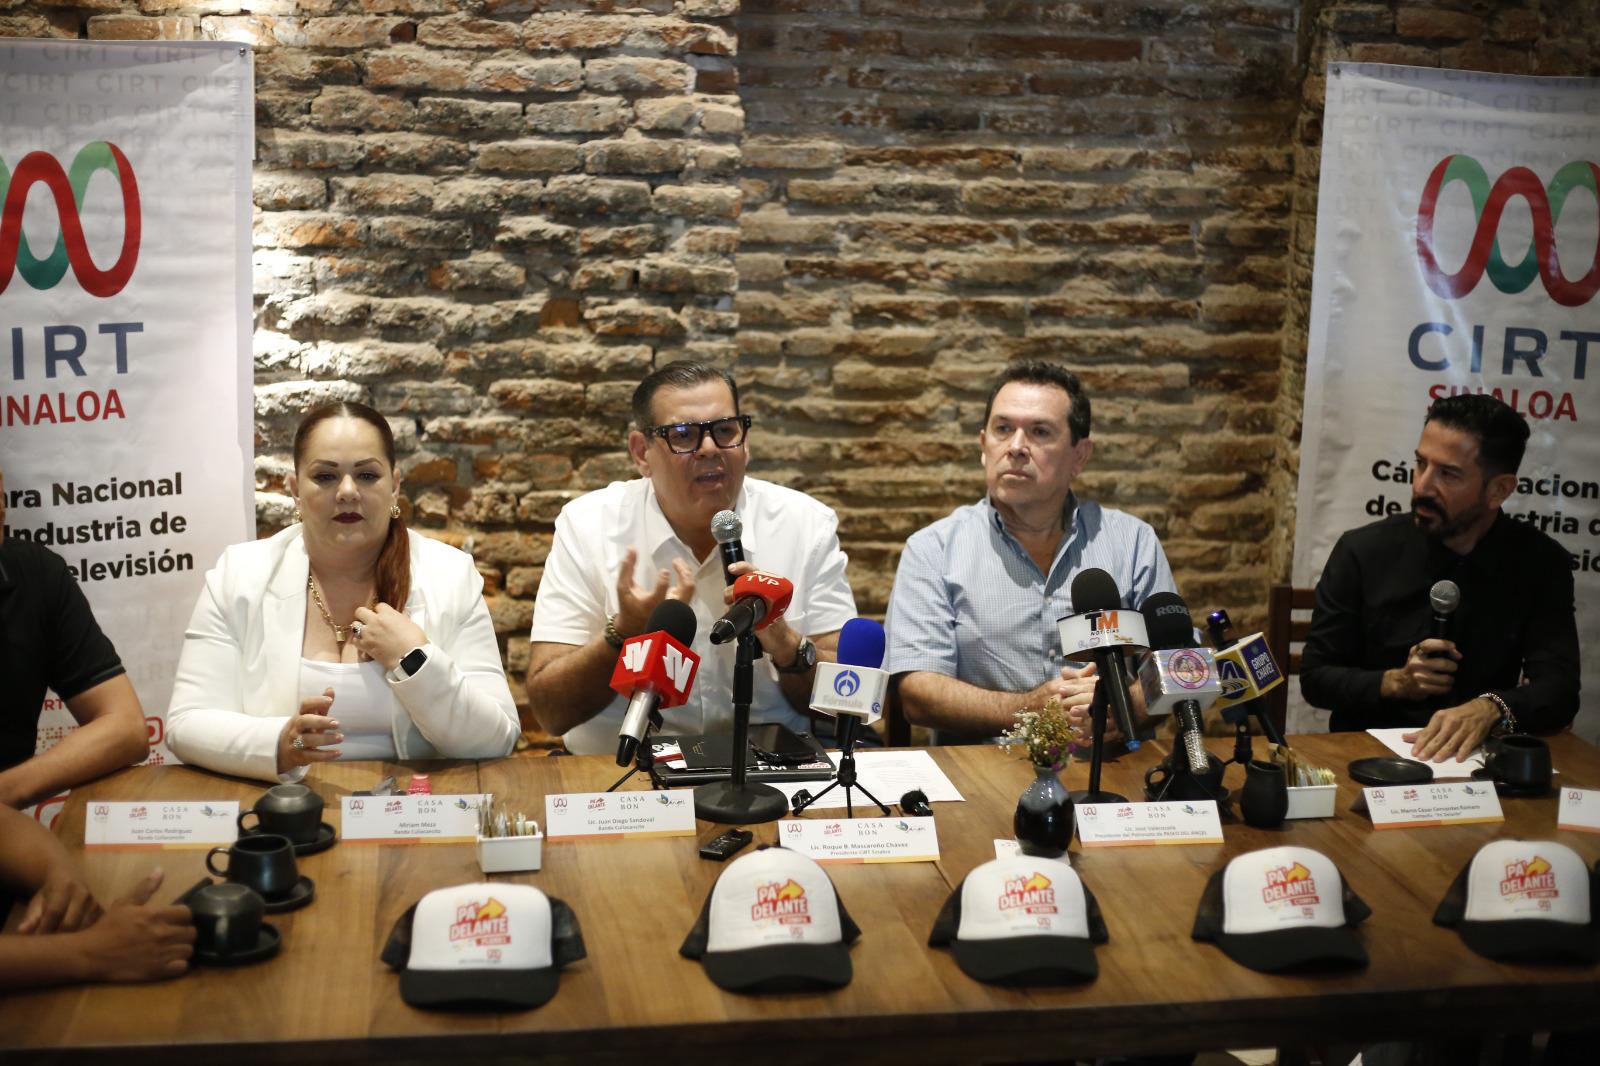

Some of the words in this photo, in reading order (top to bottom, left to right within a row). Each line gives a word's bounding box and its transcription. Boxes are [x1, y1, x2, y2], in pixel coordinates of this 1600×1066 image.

[12, 322, 144, 381] IRT
[1408, 322, 1600, 380] CIRT
[0, 389, 126, 427] NALOA
[52, 472, 183, 506] Nacional
[1366, 495, 1402, 516] de
[150, 512, 187, 535] de
[67, 549, 194, 582] elevisión
[746, 574, 780, 587] TVP
[1085, 611, 1118, 632] TM
[1263, 880, 1316, 903] DELANTE
[1501, 874, 1555, 895] DELANTE
[753, 899, 808, 920] DELANTE
[1000, 890, 1054, 910] DELANTE
[450, 917, 508, 941] DELANTE
